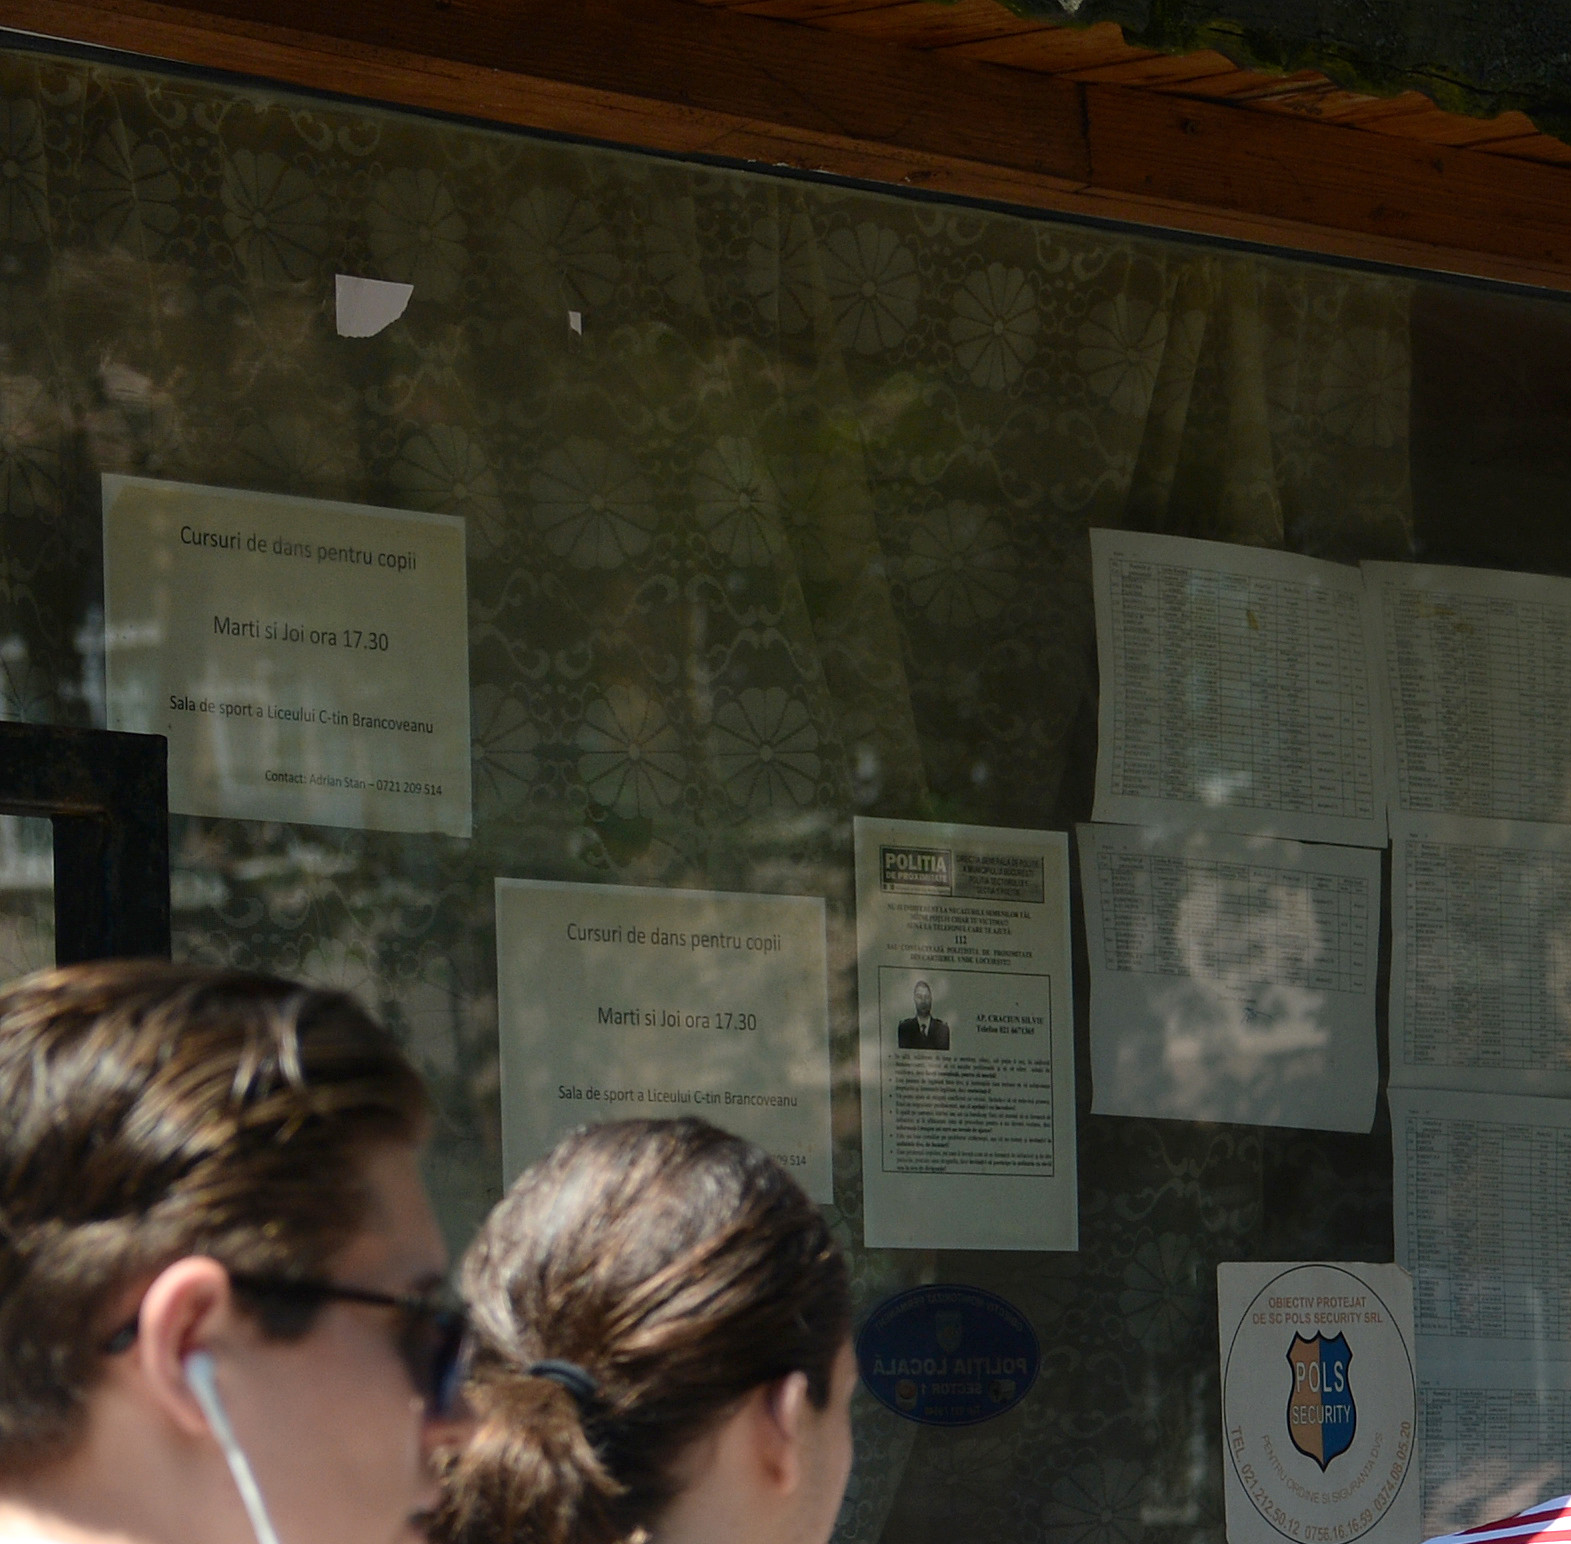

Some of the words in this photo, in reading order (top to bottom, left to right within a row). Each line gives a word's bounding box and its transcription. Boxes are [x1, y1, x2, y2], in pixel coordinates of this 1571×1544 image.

[180, 526, 241, 551] Cursuri
[246, 533, 267, 554] de
[272, 536, 312, 558] dans
[317, 543, 372, 567] pentru
[378, 551, 417, 573] copii
[214, 616, 260, 639] Marti
[265, 622, 278, 640] si
[282, 623, 304, 643] Joi
[310, 630, 337, 647] ora
[344, 630, 389, 652] 17.30
[170, 695, 196, 712] Sala
[199, 698, 216, 714] de
[219, 701, 252, 719] sport
[256, 706, 263, 718] a
[267, 705, 316, 724] Liceului
[319, 709, 349, 726] C-tin
[353, 713, 434, 734] Brancoveanu
[265, 770, 307, 784] Contact:
[309, 774, 341, 788] Adrian
[344, 777, 366, 790] Stan
[376, 779, 400, 793] 0721
[403, 781, 422, 795] 209
[424, 783, 443, 796] 514
[886, 853, 947, 873] POLITIA
[567, 923, 622, 943] Cursuri
[627, 926, 646, 944] de
[651, 928, 686, 946] dans
[691, 931, 741, 950] pentru
[746, 934, 781, 954] copii
[955, 935, 968, 944] 112
[598, 1007, 640, 1026] Marti
[645, 1010, 656, 1027] si
[661, 1010, 681, 1029] Joi
[685, 1015, 711, 1029] ora
[716, 1013, 757, 1031] 17.30
[558, 1085, 582, 1100] Sala
[586, 1086, 601, 1101] de
[603, 1089, 634, 1104] sport
[638, 1092, 644, 1102] a
[647, 1090, 692, 1105] Liceului
[694, 1090, 721, 1105] C-tin
[724, 1091, 798, 1108] Brancoveanu
[790, 1155, 807, 1167] 514
[1268, 1297, 1315, 1308] OBIECTIV
[1317, 1296, 1367, 1308] PROTEJAT
[1252, 1313, 1266, 1324] DE
[1268, 1313, 1282, 1324] SC
[1285, 1312, 1311, 1324] POLS
[1314, 1312, 1361, 1323] SECURITY
[1364, 1312, 1383, 1323] SRL
[1295, 1361, 1344, 1393] POLS
[1292, 1405, 1351, 1424] SECURITY
[1231, 1425, 1245, 1463] TEL.
